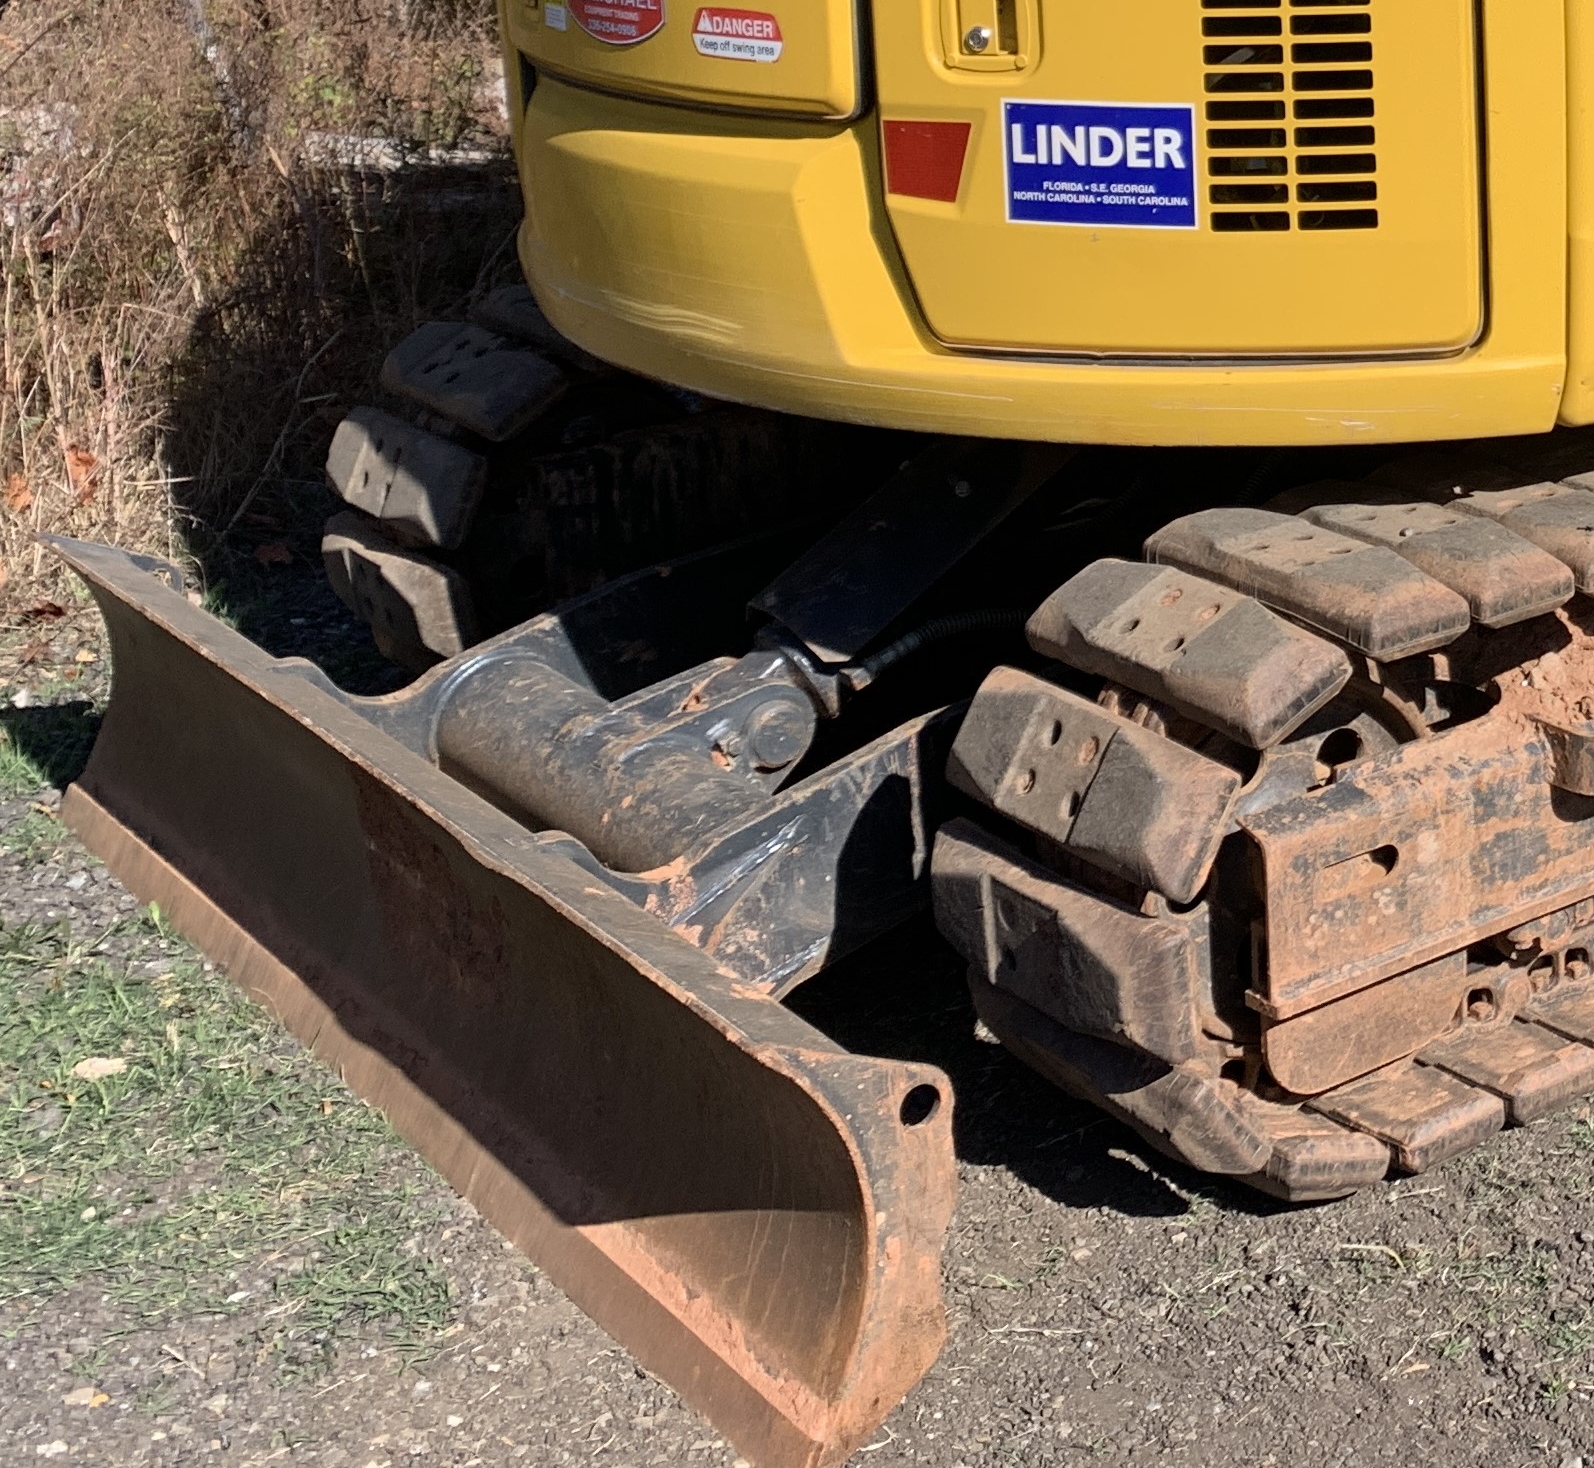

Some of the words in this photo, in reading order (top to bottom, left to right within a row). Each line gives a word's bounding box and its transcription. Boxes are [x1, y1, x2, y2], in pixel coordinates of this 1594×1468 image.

[712, 16, 773, 38] DANGER
[700, 37, 719, 52] Keep
[720, 41, 731, 52] off
[732, 42, 755, 57] swing
[757, 45, 775, 56] area
[1011, 123, 1186, 169] LINDER
[1043, 181, 1083, 192] FLORIDA
[1091, 183, 1109, 193] S.E.
[1110, 184, 1155, 194] GEORGIA
[1014, 192, 1046, 202] NORTH
[1047, 193, 1096, 204] CAROLINA
[1103, 195, 1136, 205] SOUTH
[1138, 196, 1188, 206] CAROLINA
